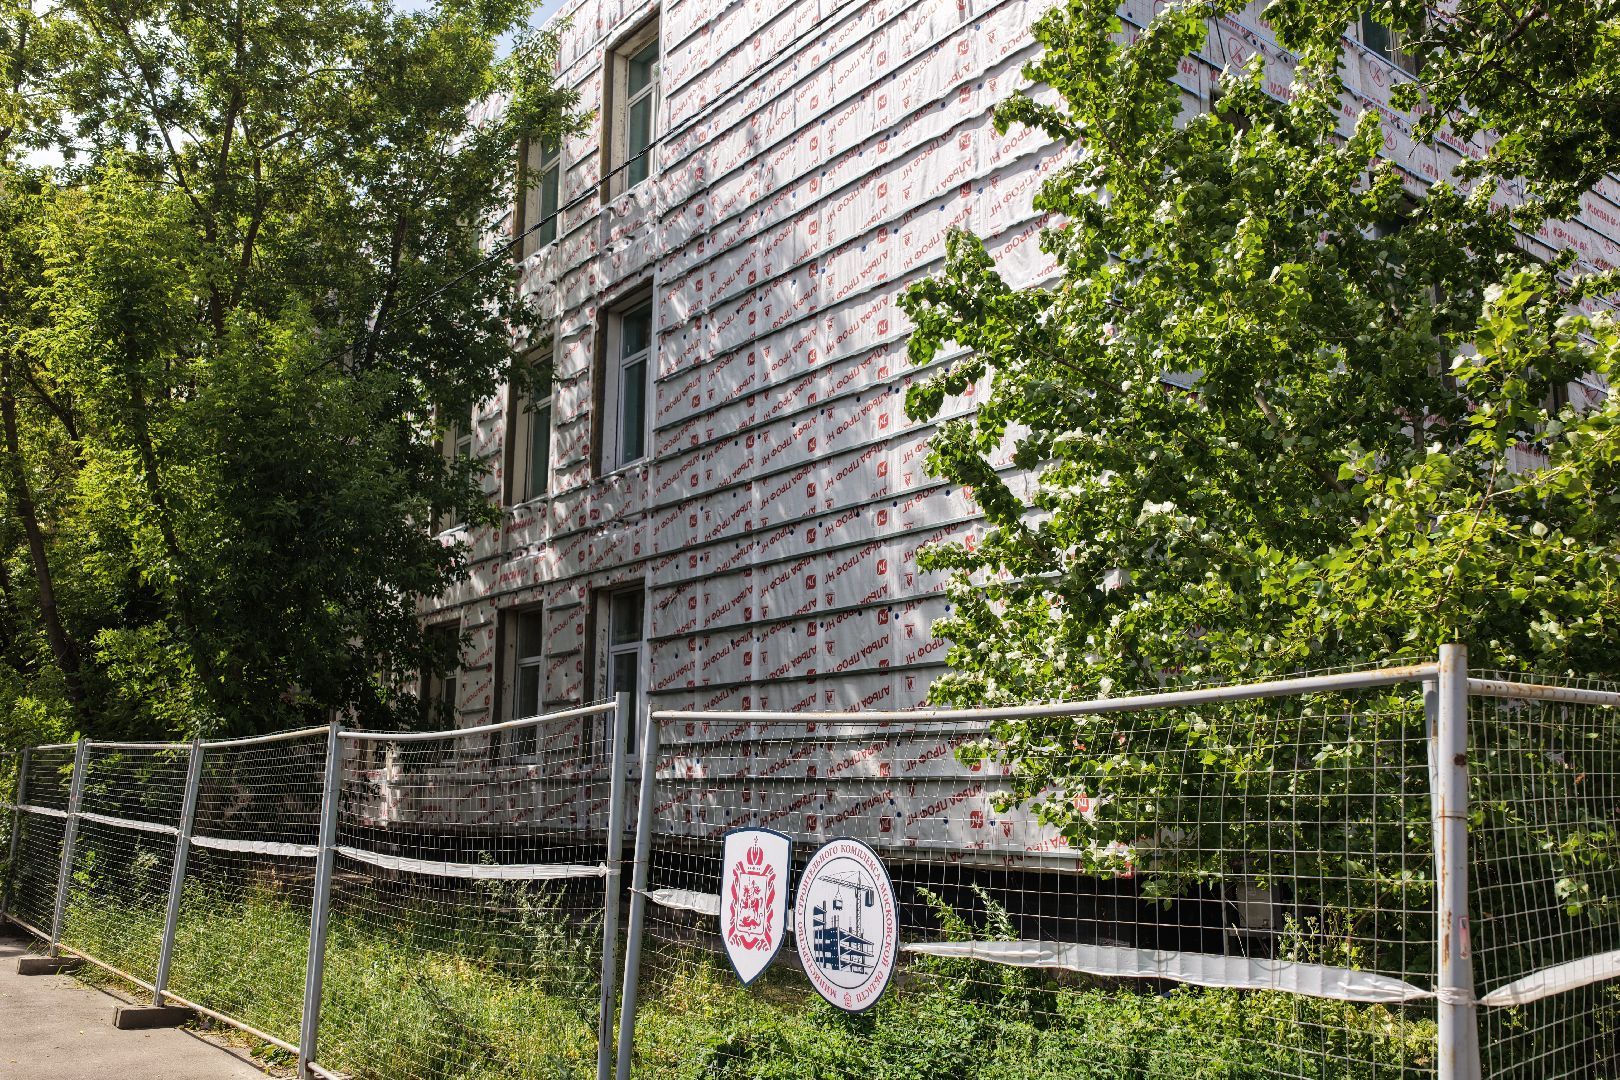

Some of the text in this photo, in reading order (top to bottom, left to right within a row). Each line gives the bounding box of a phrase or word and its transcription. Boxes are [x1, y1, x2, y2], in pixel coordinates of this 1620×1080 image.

[837, 101, 857, 126] ПРОФ
[940, 157, 971, 187] АЛЬФА
[826, 186, 859, 222] ПРОФ НГ
[763, 224, 792, 256] ПРОФ НГ
[914, 206, 971, 260] АЛЬФА ПРОФ
[1004, 222, 1034, 253] ПРОФ
[717, 271, 736, 294] ПРОФ
[836, 249, 887, 299] АЛЬФА ПРОФ
[772, 284, 817, 329] АЛЬФА ПРОФ
[860, 296, 888, 323] АЛЬФА
[716, 313, 734, 335] ПРОФ
[836, 319, 859, 343] ПРОФ
[792, 328, 816, 353] АЛЬФА
[715, 353, 732, 375] ПРОФ
[771, 349, 791, 371] ПРОФ
[836, 344, 888, 390] АЛЬФА ПРОФ
[664, 391, 681, 414] ПРОФ
[771, 373, 816, 413] АЛЬФА ПРОФ
[860, 390, 889, 415] АЛЬФА
[836, 412, 859, 435] ПРОФ
[663, 432, 680, 451] ПРОФ
[761, 416, 816, 465] АЛЬФА ПРОФ НГ
[732, 457, 754, 479] АЛЬФА
[824, 439, 885, 491] АЛЬФА ПРОФ НГ
[902, 449, 913, 463] НГ
[661, 454, 698, 490] АЛЬФА ПРОФ
[760, 461, 816, 508] АЛЬФА ПРОФ НГ
[732, 500, 751, 519] АЛЬФА
[902, 499, 913, 512] НГ
[660, 509, 678, 529] ПРОФ
[712, 517, 729, 535] ПРОФ
[824, 508, 856, 537] ПРОФ НГ
[760, 525, 789, 554] ПРОФ НГ
[730, 543, 753, 562] АЛЬФА
[903, 549, 913, 562] НГ
[824, 571, 833, 582] НГ
[836, 555, 859, 576] ПРОФ
[760, 584, 768, 597] НГ
[769, 571, 788, 588] ПРОФ
[704, 585, 752, 626] АЛЬФА ПРОФ НГ
[761, 631, 768, 642] НГ
[825, 618, 835, 632] НГ
[703, 629, 751, 669] АЛЬФА ПРОФ НГ
[836, 635, 888, 671] АЛЬФА ПРОФ
[918, 636, 944, 656] ПРОФ
[769, 645, 816, 679] АЛЬФА ПРОФ
[657, 660, 695, 689] АЛЬФА ПРОФ
[710, 690, 728, 706] ПРОФ
[861, 686, 889, 707] АЛЬФА
[905, 743, 946, 771] ПРОФ НГ
[906, 811, 917, 826] НГ
[798, 844, 893, 1002] МИНИСТЕРСТВО СТРОИТЕЛЬНОГО КОМПЛЕКСА МОСКОВСКОЙ ОБЛАСТИ
